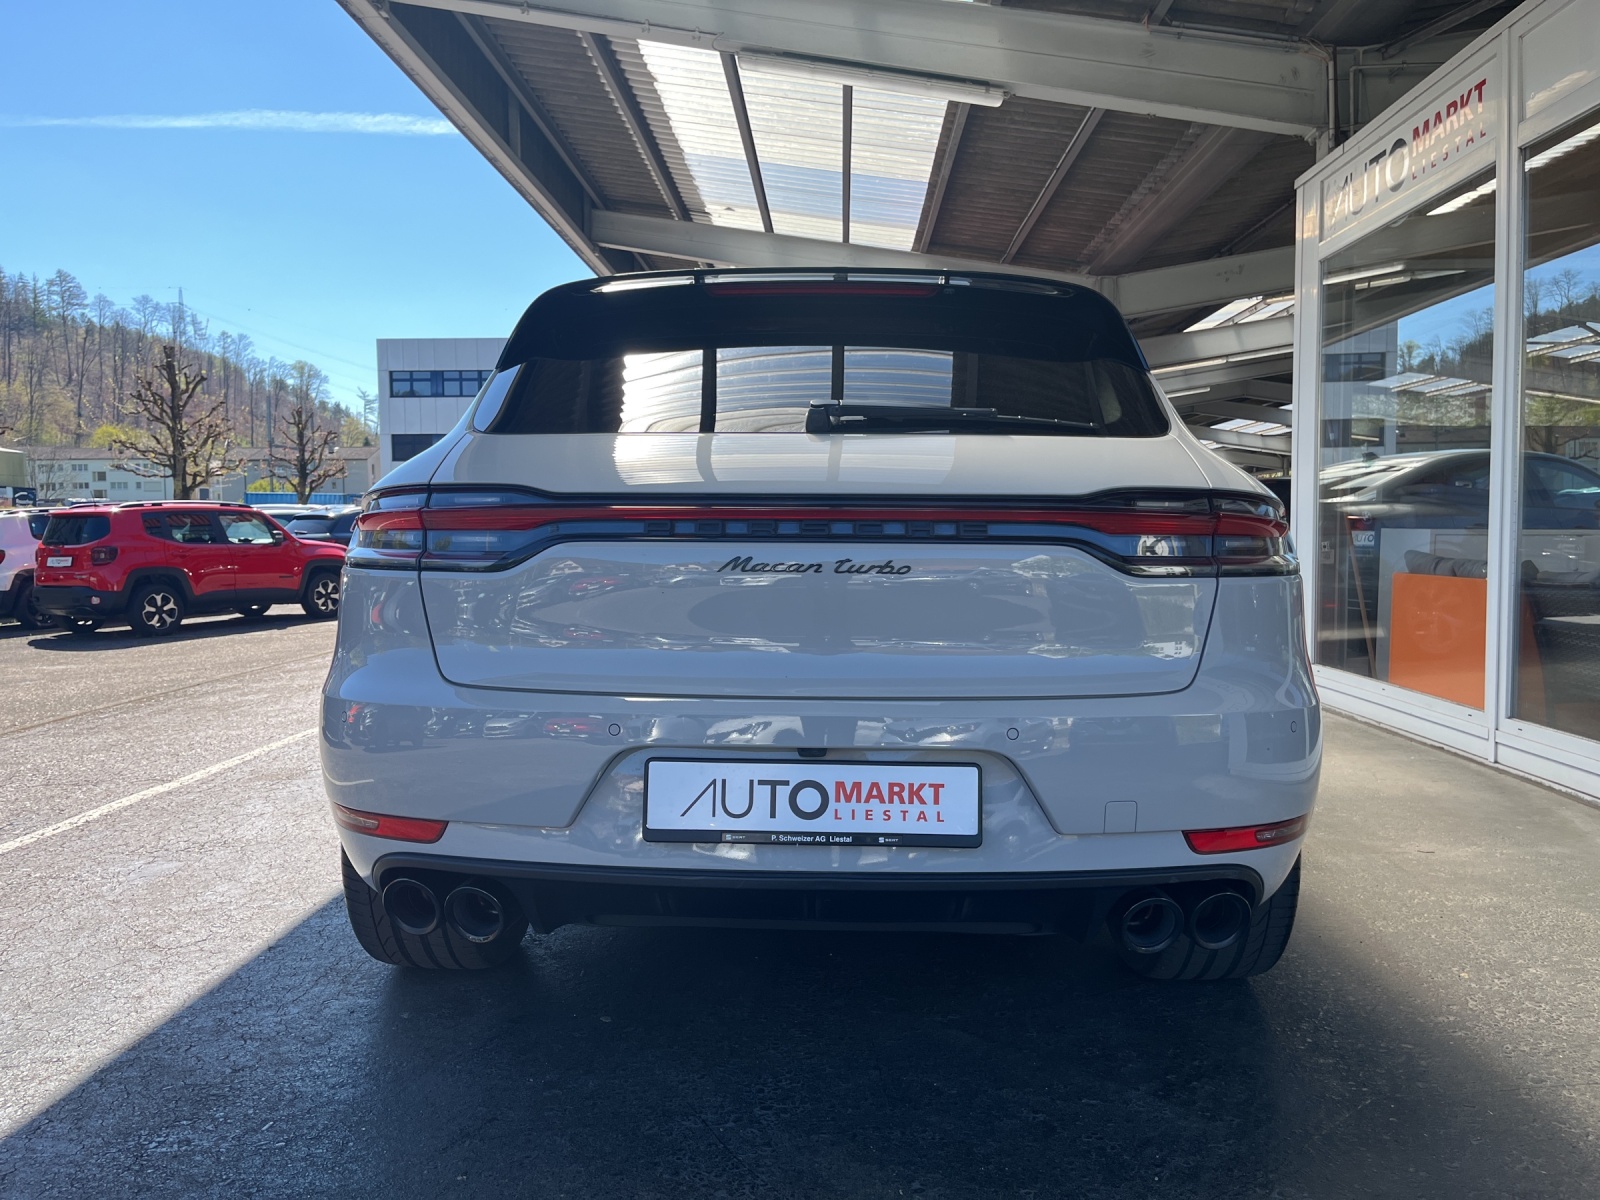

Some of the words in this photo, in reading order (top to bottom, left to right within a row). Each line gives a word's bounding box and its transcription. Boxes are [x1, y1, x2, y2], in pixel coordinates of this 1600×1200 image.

[1331, 138, 1410, 226] AUTO
[1412, 78, 1487, 157] MARKT
[1412, 122, 1487, 180] LIESTAL
[644, 519, 988, 538] PORSCHE
[717, 556, 823, 573] Macan
[833, 558, 912, 575] turbo
[680, 778, 830, 820] AUTO
[834, 781, 945, 805] MARKT
[834, 809, 945, 822] LIESTAL
[829, 835, 853, 843] Liestal
